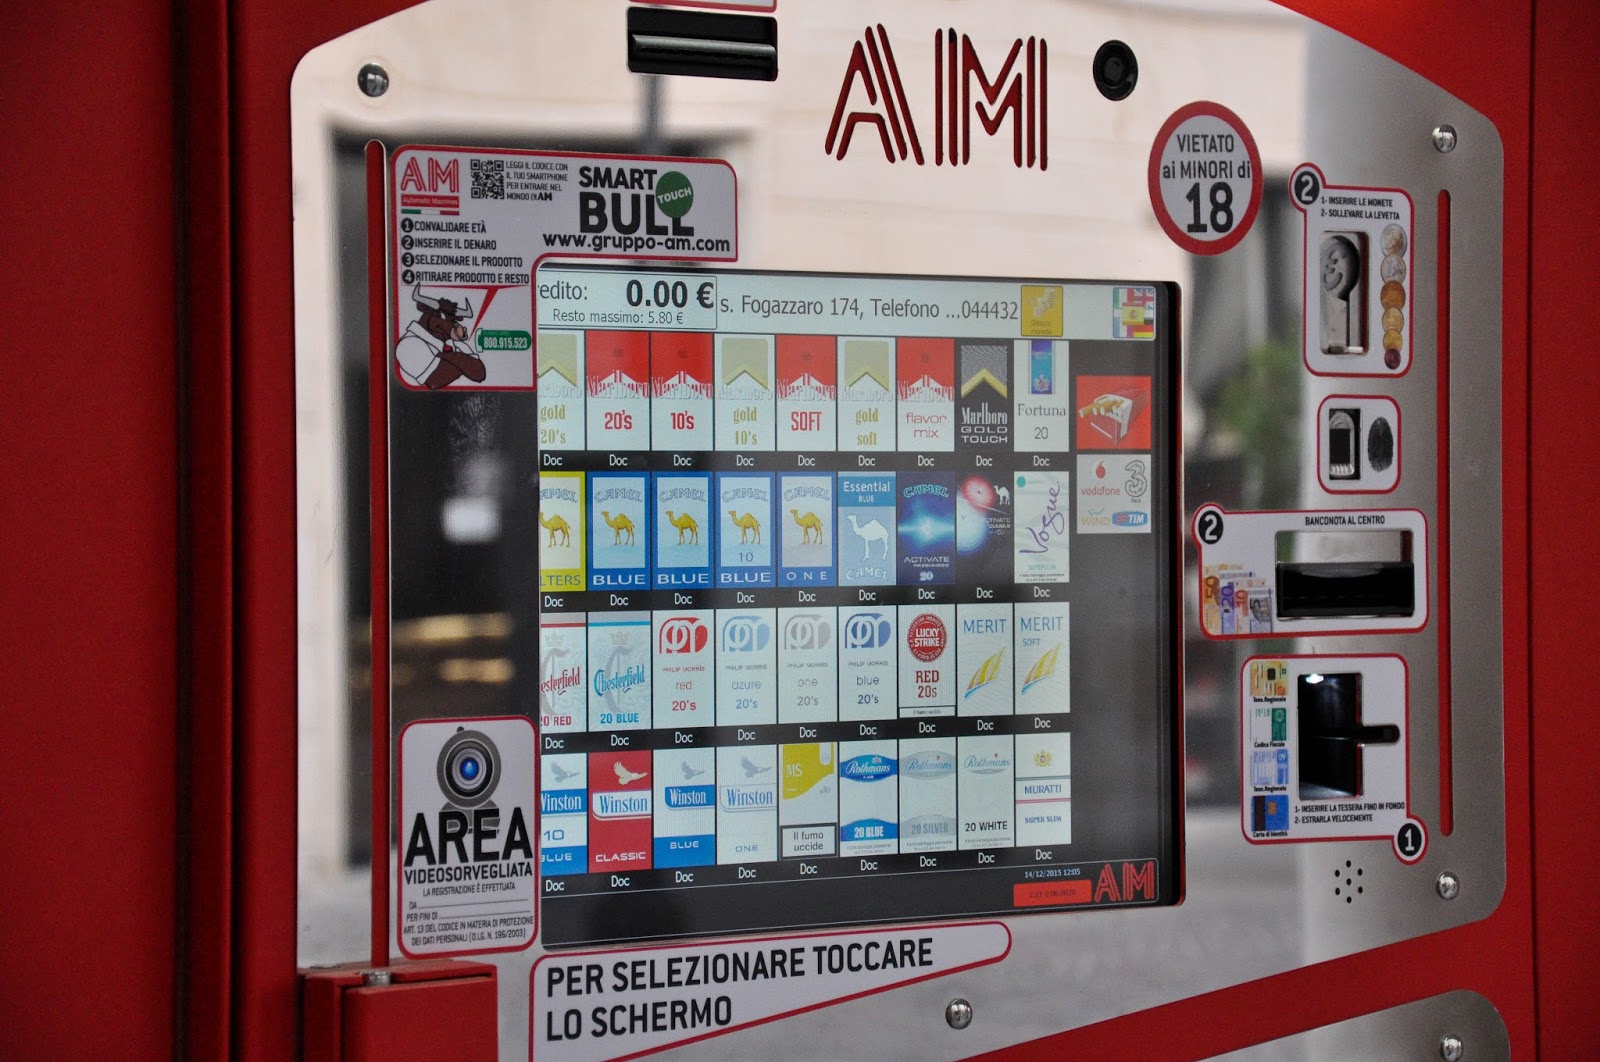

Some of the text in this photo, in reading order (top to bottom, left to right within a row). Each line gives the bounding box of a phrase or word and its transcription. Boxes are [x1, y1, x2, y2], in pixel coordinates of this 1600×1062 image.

[824, 23, 1048, 171] AM
[1177, 135, 1234, 153] VIETATO
[506, 161, 525, 169] LEGGI
[555, 162, 568, 171] CON
[1162, 160, 1250, 179] ai MINORI di
[401, 157, 460, 192] AM
[526, 173, 568, 181] SMARTPHONE
[579, 166, 657, 190] SMART
[506, 182, 562, 191] PER ENTRARE NEL
[537, 193, 553, 201] AM
[658, 187, 692, 204] TOUCH
[1185, 181, 1234, 233] 18
[1329, 197, 1393, 207] INSERIRE MONETE
[580, 191, 694, 236] BULL
[1328, 209, 1400, 220] SOLLEVARE LEVETTA
[414, 219, 486, 233] CONVALIDARE ETÀ
[415, 238, 497, 250] INSERIRE DENARO
[543, 233, 730, 252] www.gruppo-am.com
[415, 255, 523, 268] SELEZIONARE IL PRODOTTO
[415, 271, 529, 284] RITIRARE PRODOTTO RESTO
[626, 280, 714, 309] 0.00 €
[742, 295, 940, 319] Fogazzaro 174, Telefono
[553, 309, 673, 324] Resto massimo: 5.80
[484, 337, 527, 348] 800.915.523
[540, 404, 566, 422] gold
[733, 407, 757, 424] gold
[962, 403, 1008, 425] Marlboro
[1017, 403, 1067, 417] Fortuna
[604, 410, 633, 430] 20's
[671, 410, 694, 430] 10's
[791, 411, 822, 431] SOFT
[855, 408, 879, 425] gold
[905, 412, 947, 424] flavor
[913, 428, 939, 439] mix
[961, 426, 1008, 434] GOLD
[1034, 427, 1049, 440] 20
[541, 429, 566, 444] 20's
[735, 431, 757, 445] 10's
[857, 432, 877, 445] soft
[543, 454, 563, 466] Doc
[673, 455, 692, 466] Doc
[798, 455, 815, 466] Doc
[918, 455, 935, 466] Doc
[1033, 455, 1050, 466] Doc
[843, 480, 890, 493] Essential
[903, 484, 950, 498] CAMEL
[1081, 486, 1120, 496] vodafone
[594, 487, 643, 503] CAMEL
[658, 487, 707, 503] CAMEL
[721, 487, 769, 503] CAMEL
[783, 486, 830, 502] CAMEL
[1019, 480, 1065, 554] Vogue
[1305, 515, 1385, 526] BANCONOTA AL CENTRO
[738, 552, 754, 562] 10
[593, 574, 645, 585] BLUE
[657, 573, 709, 585] BLUE
[720, 572, 771, 583] BLUE
[846, 568, 888, 581] CAMEL
[963, 619, 1006, 634] MERIT
[1021, 616, 1063, 632] MERIT
[915, 628, 939, 637] LUCKY
[914, 638, 940, 647] STRIKE
[1023, 638, 1040, 647] SOFT
[594, 663, 645, 696] Chesterfield
[857, 676, 879, 686] blue
[916, 670, 939, 683] RED
[675, 679, 692, 691] red
[731, 680, 762, 690] azure
[797, 678, 818, 688] one
[918, 685, 937, 698] 20s
[736, 698, 758, 709] 20's
[797, 695, 819, 706] 20's
[857, 694, 879, 704] 20's
[672, 700, 696, 712] 20's
[553, 716, 571, 726] RED
[600, 712, 639, 724] 20 BLUE
[860, 724, 877, 735] Doc
[977, 719, 994, 731] Doc
[610, 735, 629, 747] Doc
[738, 730, 755, 741] Doc
[846, 760, 891, 774] Rothmans
[907, 758, 952, 772] Rothmans
[963, 753, 1010, 769] Rothmans
[786, 763, 802, 778] MS
[1024, 784, 1062, 794] MURATTI
[669, 787, 707, 806] Winston
[726, 787, 773, 806] Winston
[599, 795, 648, 814] Winston
[1302, 802, 1405, 813] INSERIRE TESSERA FINO FONDO
[1024, 816, 1045, 824] SUPER
[1302, 814, 1373, 824] ESTRARLA VELOCEMENTE
[866, 826, 884, 837] BLUE
[965, 820, 1008, 832] 20 WHITE
[404, 807, 533, 867] AREA
[544, 829, 565, 841] 10
[801, 830, 824, 840] fumo
[670, 840, 699, 849] BLUE
[794, 842, 824, 851] uccide
[595, 852, 646, 862] CLASSIC
[1036, 849, 1052, 860] Doc
[919, 856, 937, 868] Doc
[404, 862, 533, 885] VIDEOSORVEGLIATA
[800, 863, 817, 875] Doc
[1025, 869, 1062, 878] 14/12/2015
[675, 871, 694, 884] Doc
[1094, 861, 1154, 903] AM
[432, 882, 515, 896] REGISTRAZIONE EFFETTUATA
[546, 880, 565, 892] Doc
[406, 912, 430, 921] PER FINI
[426, 924, 437, 933] DEL
[467, 920, 491, 929] MATERIA
[499, 916, 533, 927] PROTEZIONE
[436, 934, 468, 944] PERSONALI
[547, 938, 933, 997] PER SELEZIONARE TOCCARE
[547, 996, 732, 1041] LO SCHERMO
